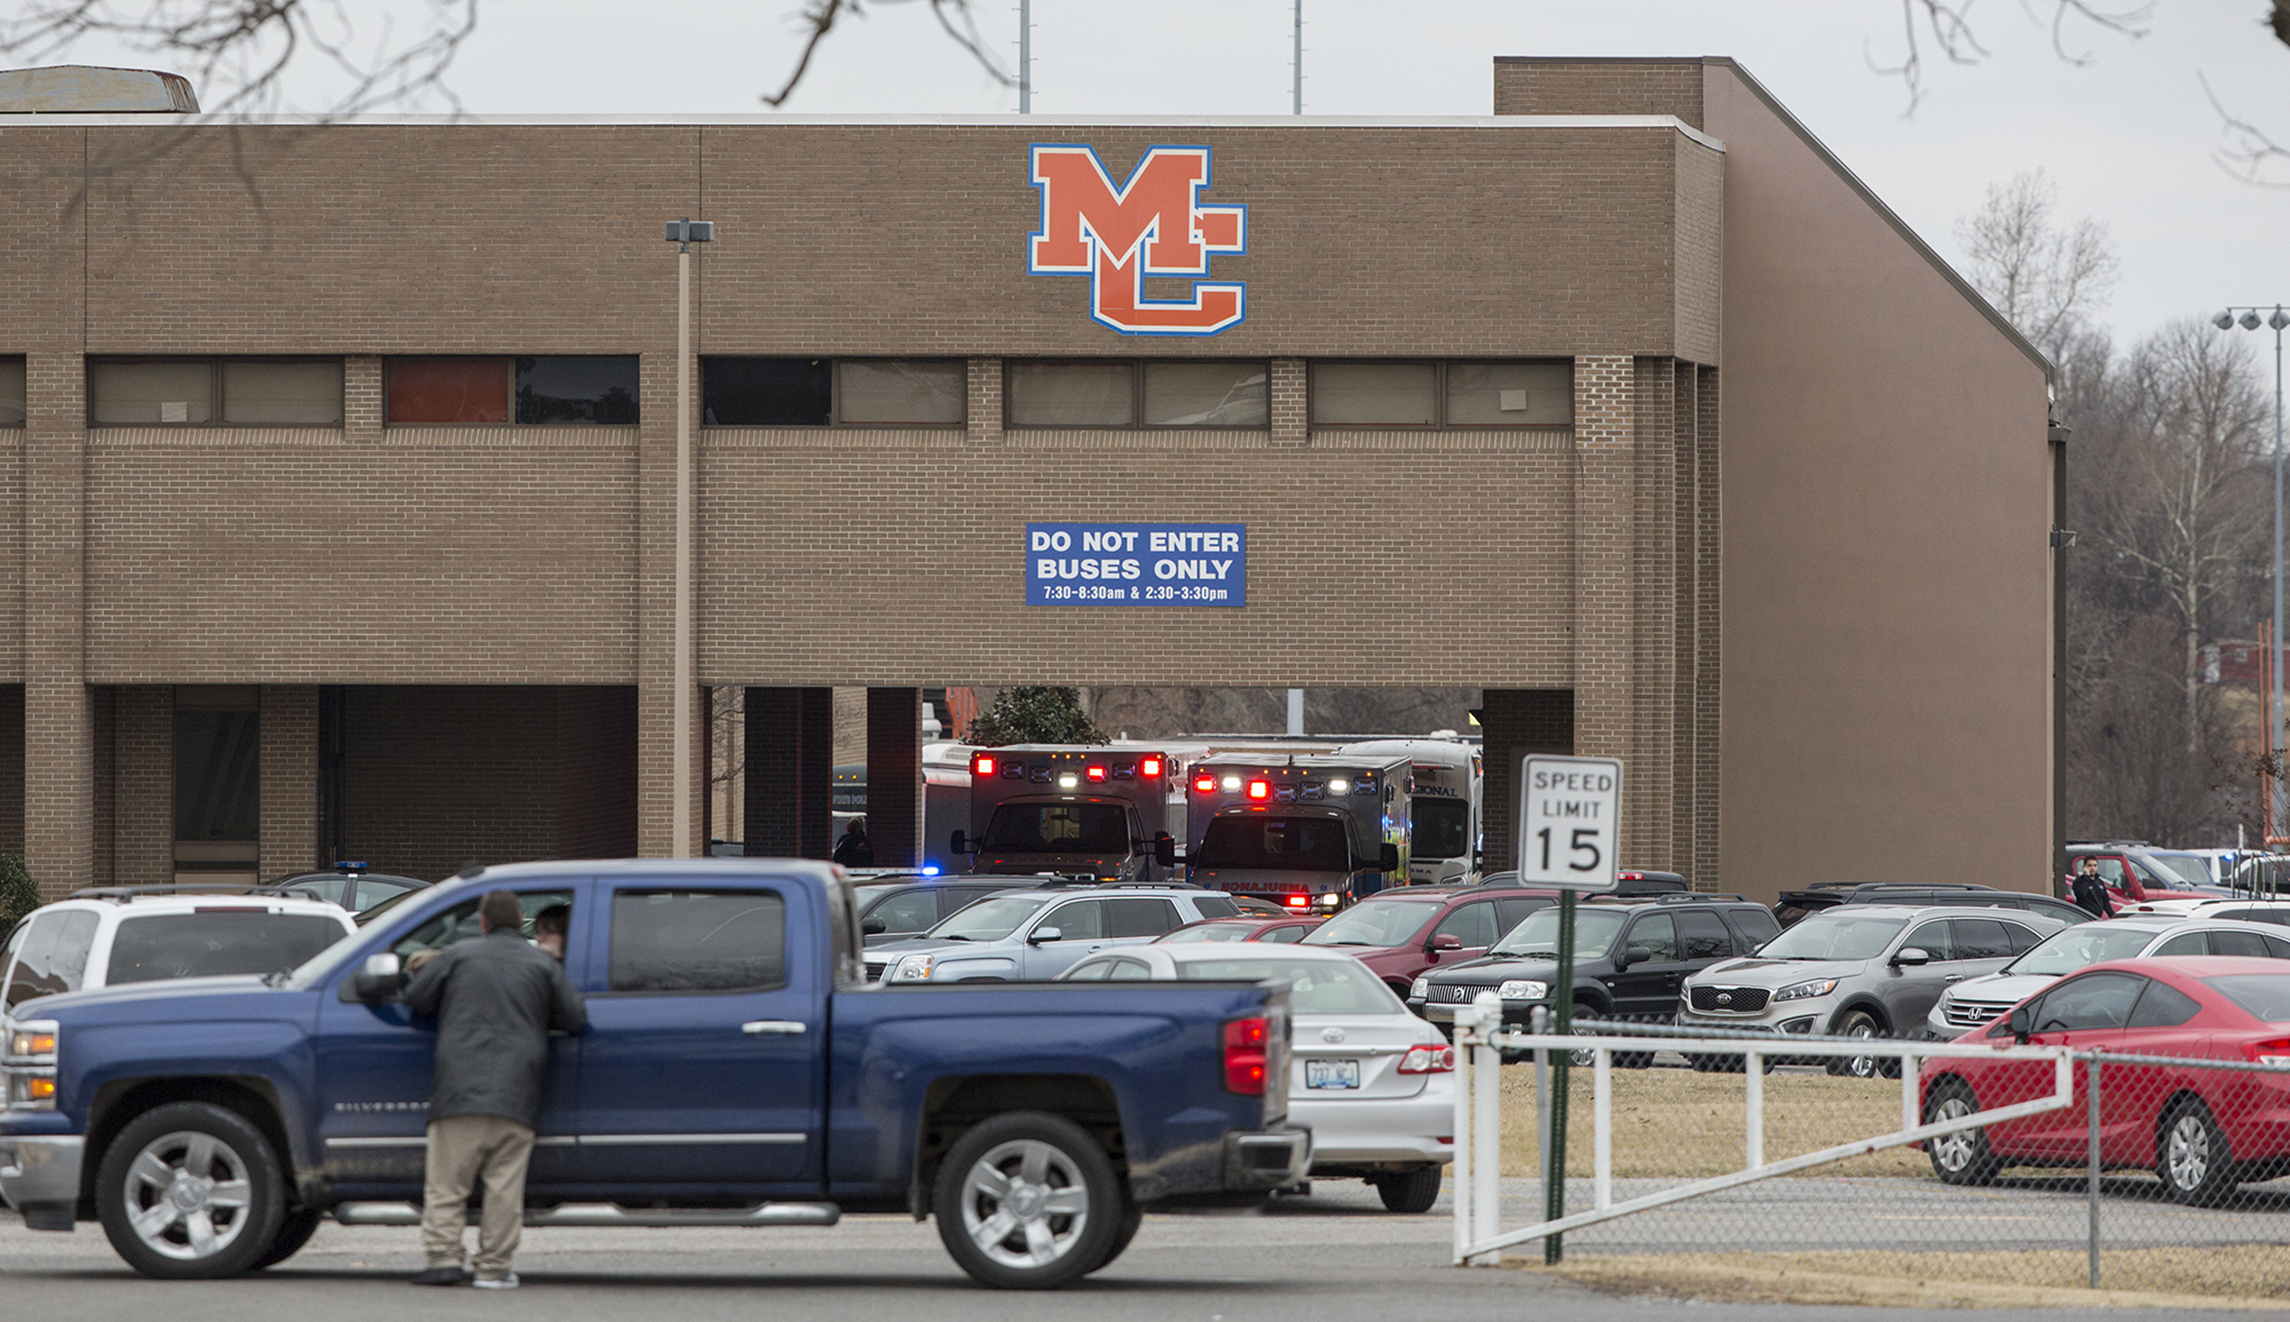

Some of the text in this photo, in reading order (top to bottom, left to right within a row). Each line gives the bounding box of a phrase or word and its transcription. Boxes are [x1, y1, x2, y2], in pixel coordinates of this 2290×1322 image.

[1027, 142, 1248, 337] MC
[1031, 531, 1239, 552] DO NOT ENTER
[1037, 558, 1233, 580] BUSES ONLY
[1043, 585, 1228, 602] 7:30-8:30am & 2:30-3:30pm
[1534, 771, 1612, 792] SPEED
[1542, 799, 1602, 819] LIMIT
[1537, 826, 1601, 872] 15
